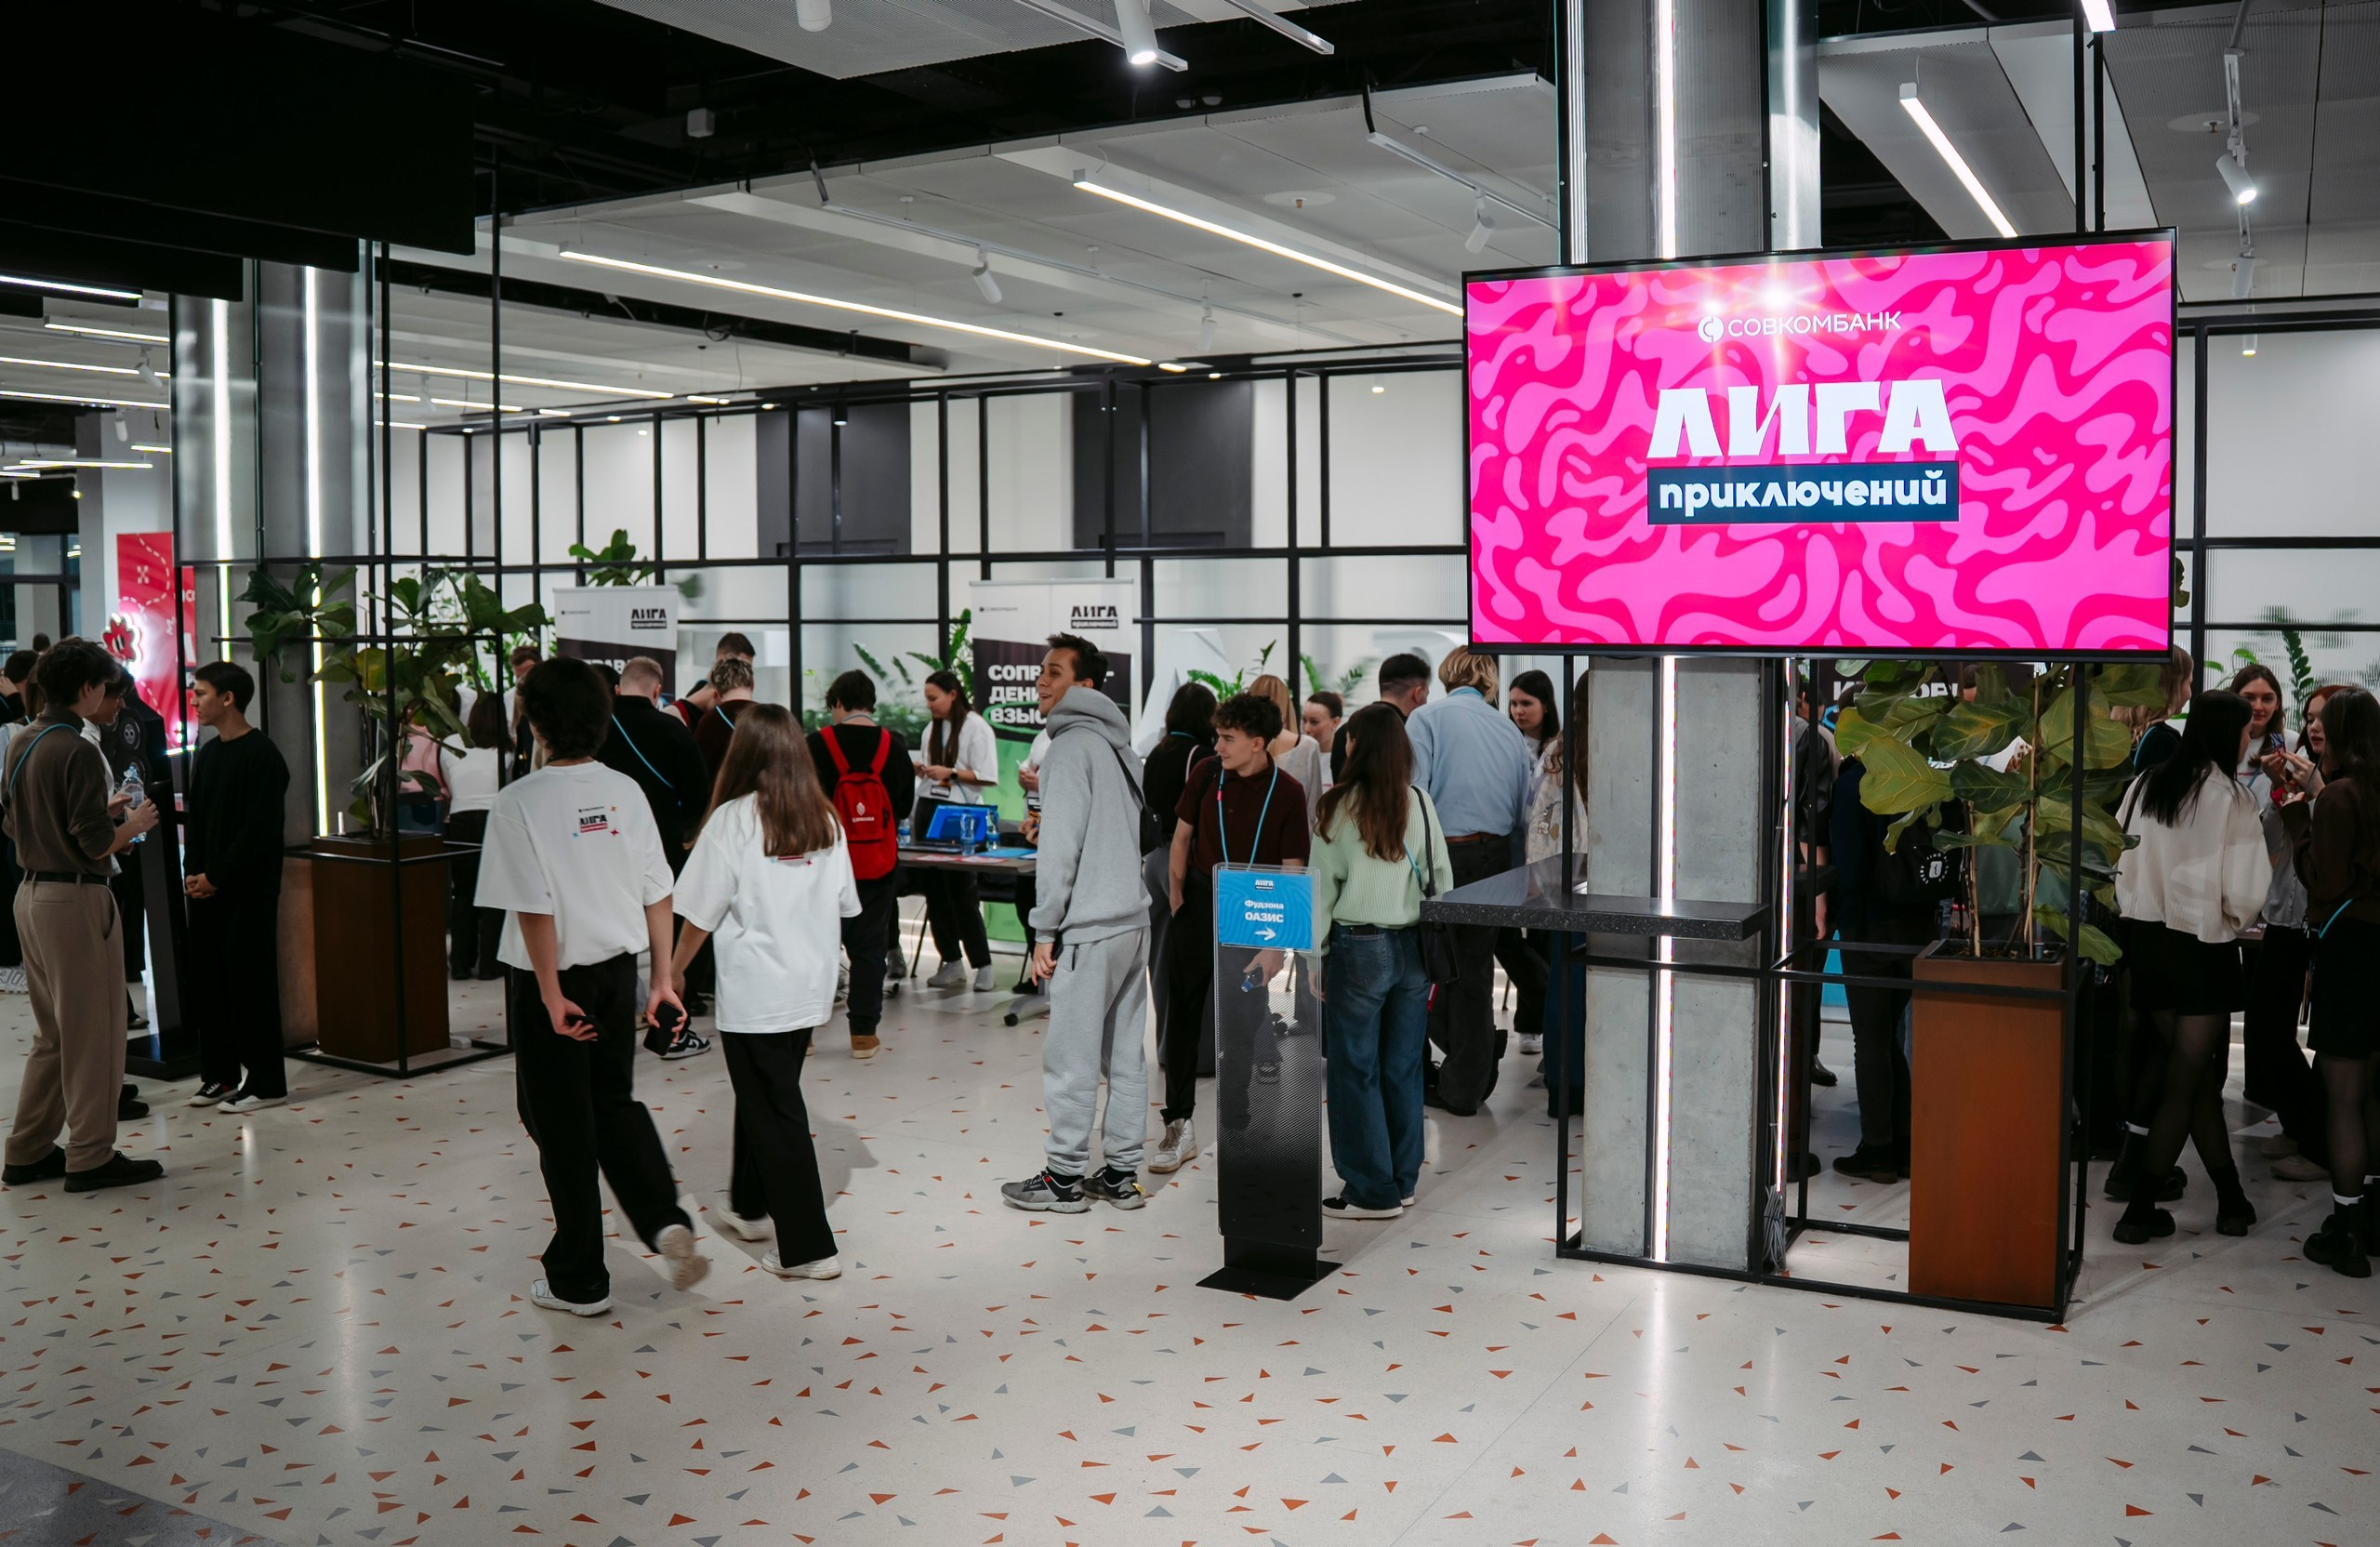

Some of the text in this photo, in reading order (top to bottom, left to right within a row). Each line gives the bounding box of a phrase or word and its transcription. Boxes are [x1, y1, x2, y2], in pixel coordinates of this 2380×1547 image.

[1727, 311, 1902, 337] СОВКОМБАНК
[1646, 378, 1960, 458] ЛИГА
[1659, 469, 1947, 517] приключений
[631, 608, 667, 619] ЛИГА
[1071, 605, 1117, 617] ЛИГА
[990, 707, 1047, 724] ВЗЫС
[1244, 899, 1284, 910] Фудзона
[1244, 911, 1284, 923] ОАЗИС
